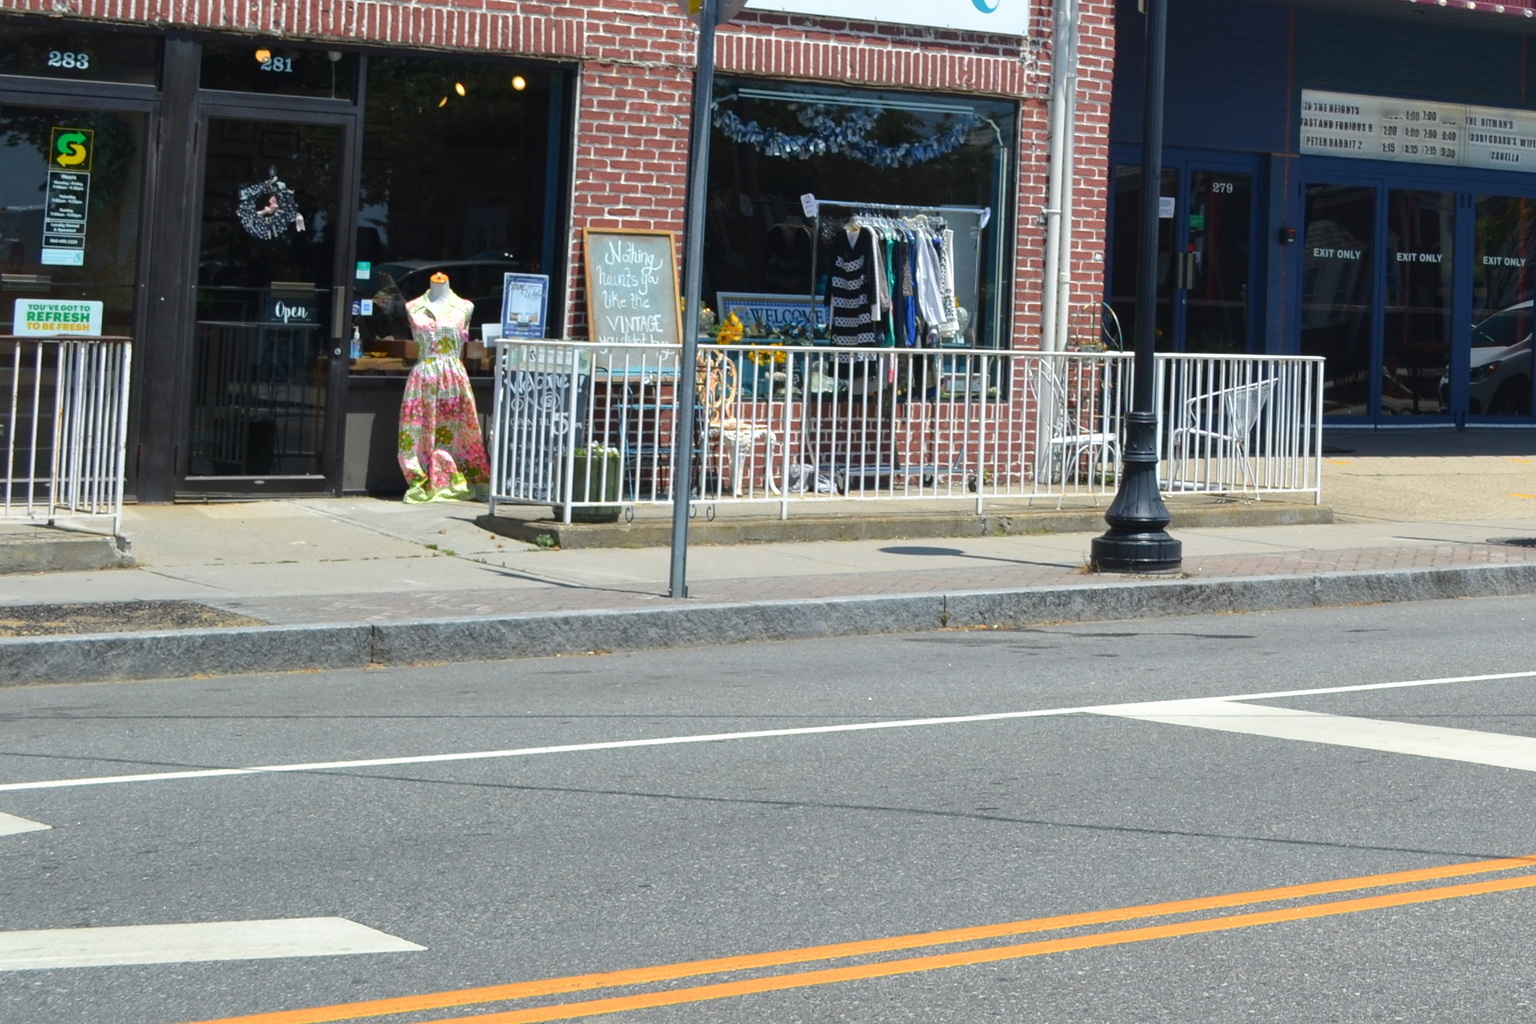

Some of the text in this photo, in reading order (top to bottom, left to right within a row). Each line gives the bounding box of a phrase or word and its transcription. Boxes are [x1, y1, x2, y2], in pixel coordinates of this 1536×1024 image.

[48, 50, 89, 70] 283
[261, 57, 293, 72] 281
[1314, 102, 1328, 114] THE
[1329, 103, 1361, 115] HEIGHTS
[1422, 111, 1437, 122] 7:00
[1318, 119, 1334, 129] AND
[1335, 120, 1367, 132] FURIOUS
[1368, 123, 1373, 133] 9
[1423, 129, 1438, 140] 7:00
[1465, 116, 1477, 126] THE
[1306, 136, 1328, 147] PETER
[1357, 140, 1363, 150] 2
[1382, 142, 1396, 154] 1:15
[1423, 145, 1437, 156] 7:15
[1212, 182, 1233, 194] 279
[605, 240, 663, 275] Nothing
[1313, 248, 1361, 260] EXIT ONLY
[1396, 252, 1443, 263] EXIT ONLY
[1483, 256, 1526, 267] EXIT ONLY
[596, 266, 660, 296] haunts you
[60, 304, 78, 312] GOT
[602, 290, 650, 310] like the
[26, 311, 90, 323] REFRESH
[275, 300, 308, 324] Open
[26, 322, 90, 331] TO BE FRESH
[605, 314, 664, 334] VINTAGE
